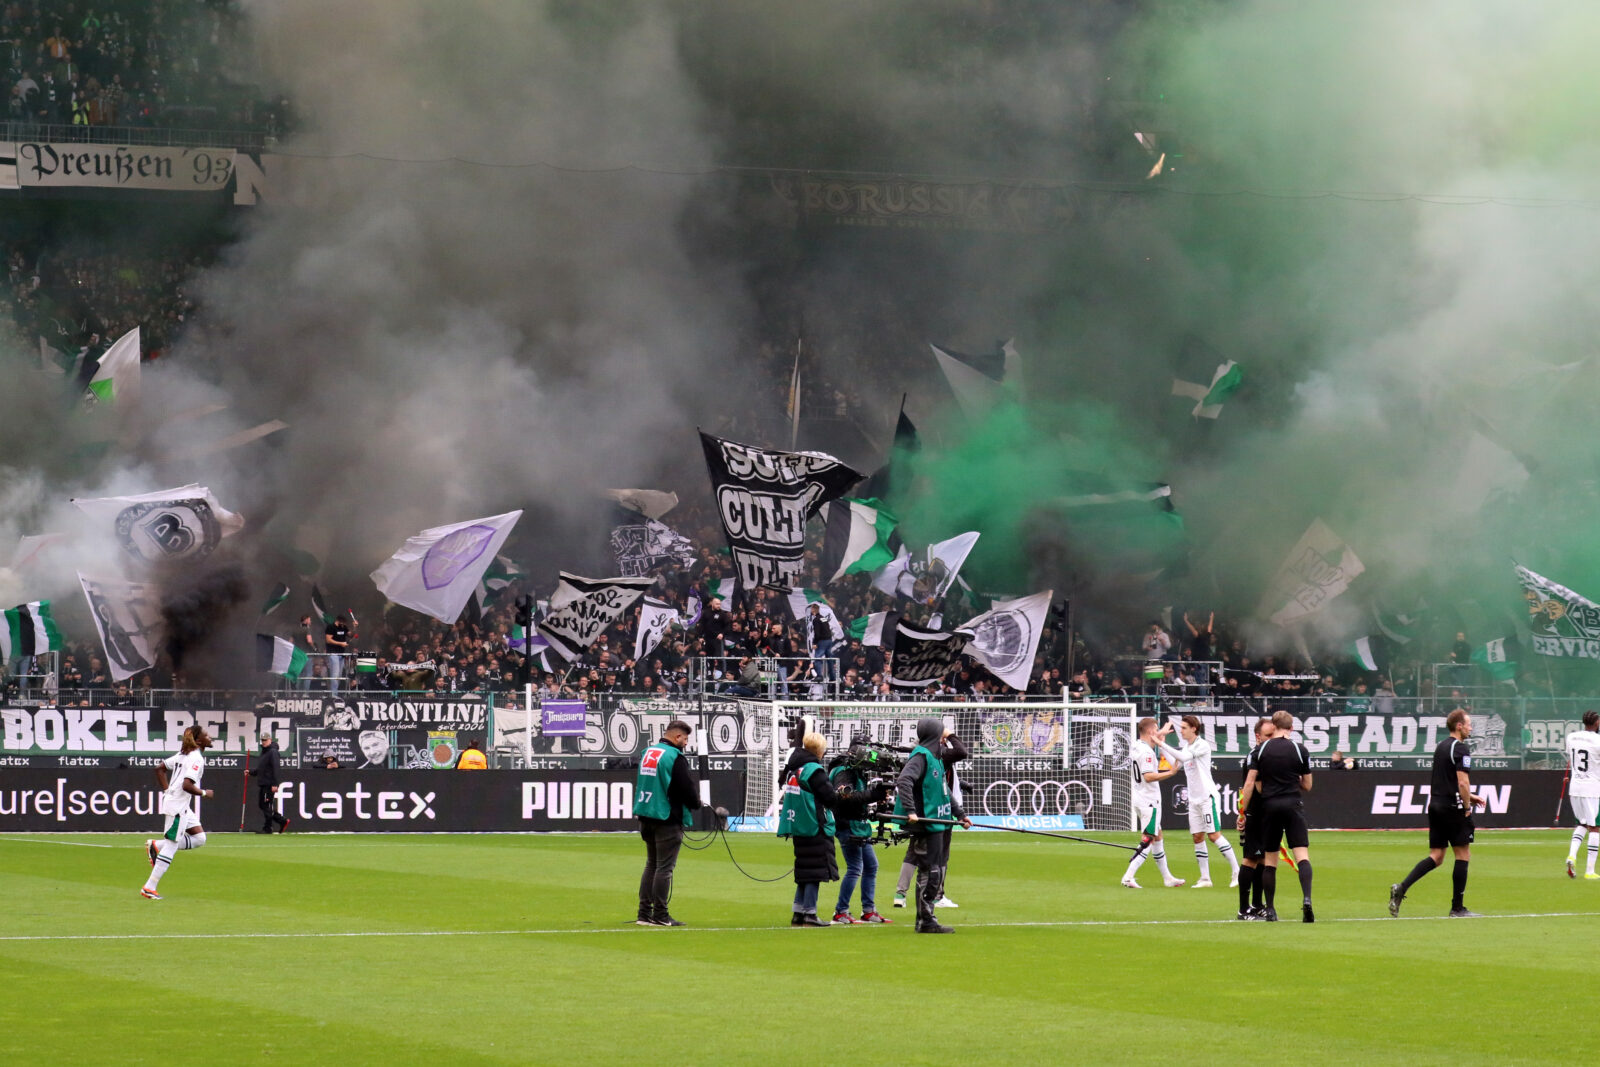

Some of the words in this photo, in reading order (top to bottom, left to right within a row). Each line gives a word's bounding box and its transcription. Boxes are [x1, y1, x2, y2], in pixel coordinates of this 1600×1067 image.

[20, 143, 173, 184] Preußen
[804, 182, 991, 218] BORUSSIA
[1533, 637, 1600, 661] ERVIC
[277, 699, 323, 713] BANDA
[356, 701, 487, 723] FRONTLINE
[1, 709, 291, 751] BOKELBERG
[58, 757, 99, 766] flatex
[204, 757, 238, 767] latex
[1003, 758, 1052, 770] flatex
[1358, 758, 1393, 768] flatex
[1474, 758, 1509, 768] flatex
[1572, 748, 1589, 773] 13
[273, 781, 437, 820] flatex
[522, 781, 633, 820] PUMA
[1000, 816, 1063, 829] JONGEN
